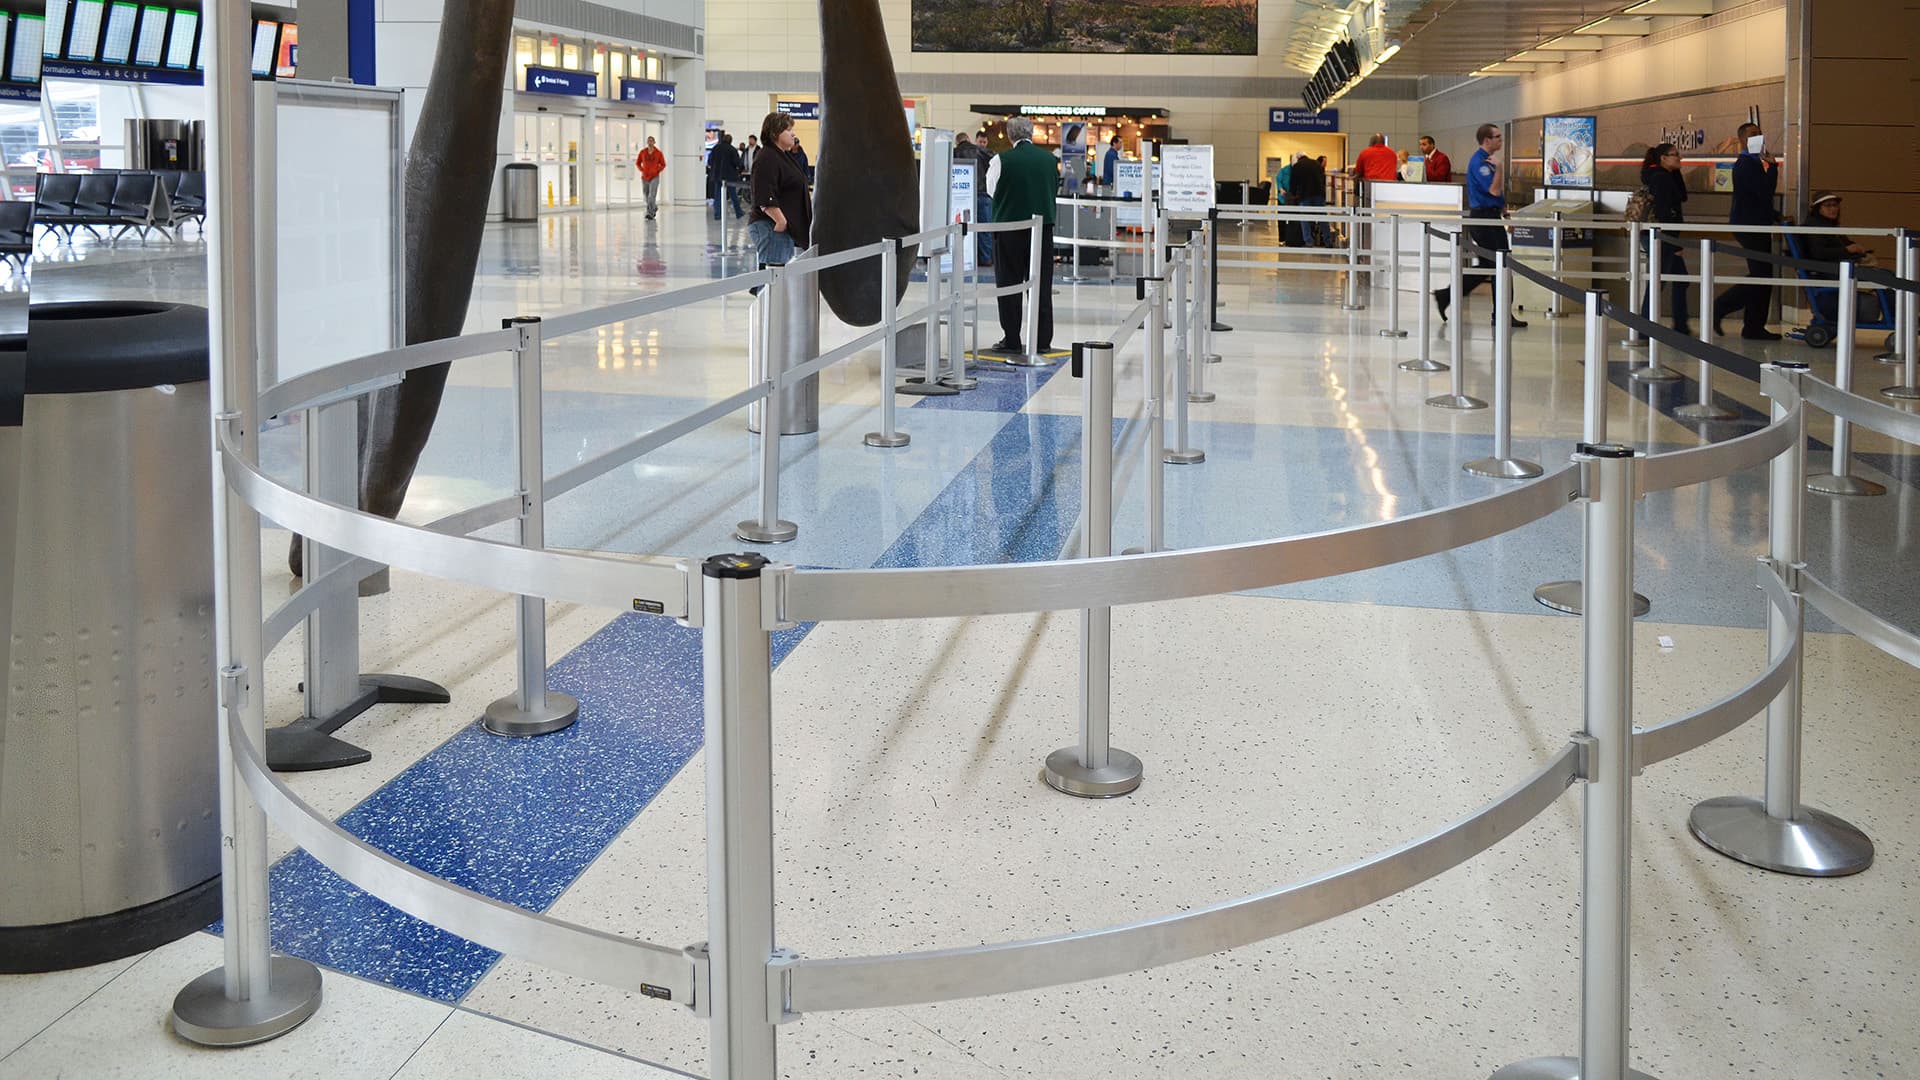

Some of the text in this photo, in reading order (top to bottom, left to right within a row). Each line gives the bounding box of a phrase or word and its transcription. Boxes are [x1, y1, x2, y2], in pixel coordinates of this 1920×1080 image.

[1020, 106, 1106, 116] STARBUCKS COFFEE
[1660, 126, 1697, 150] American
